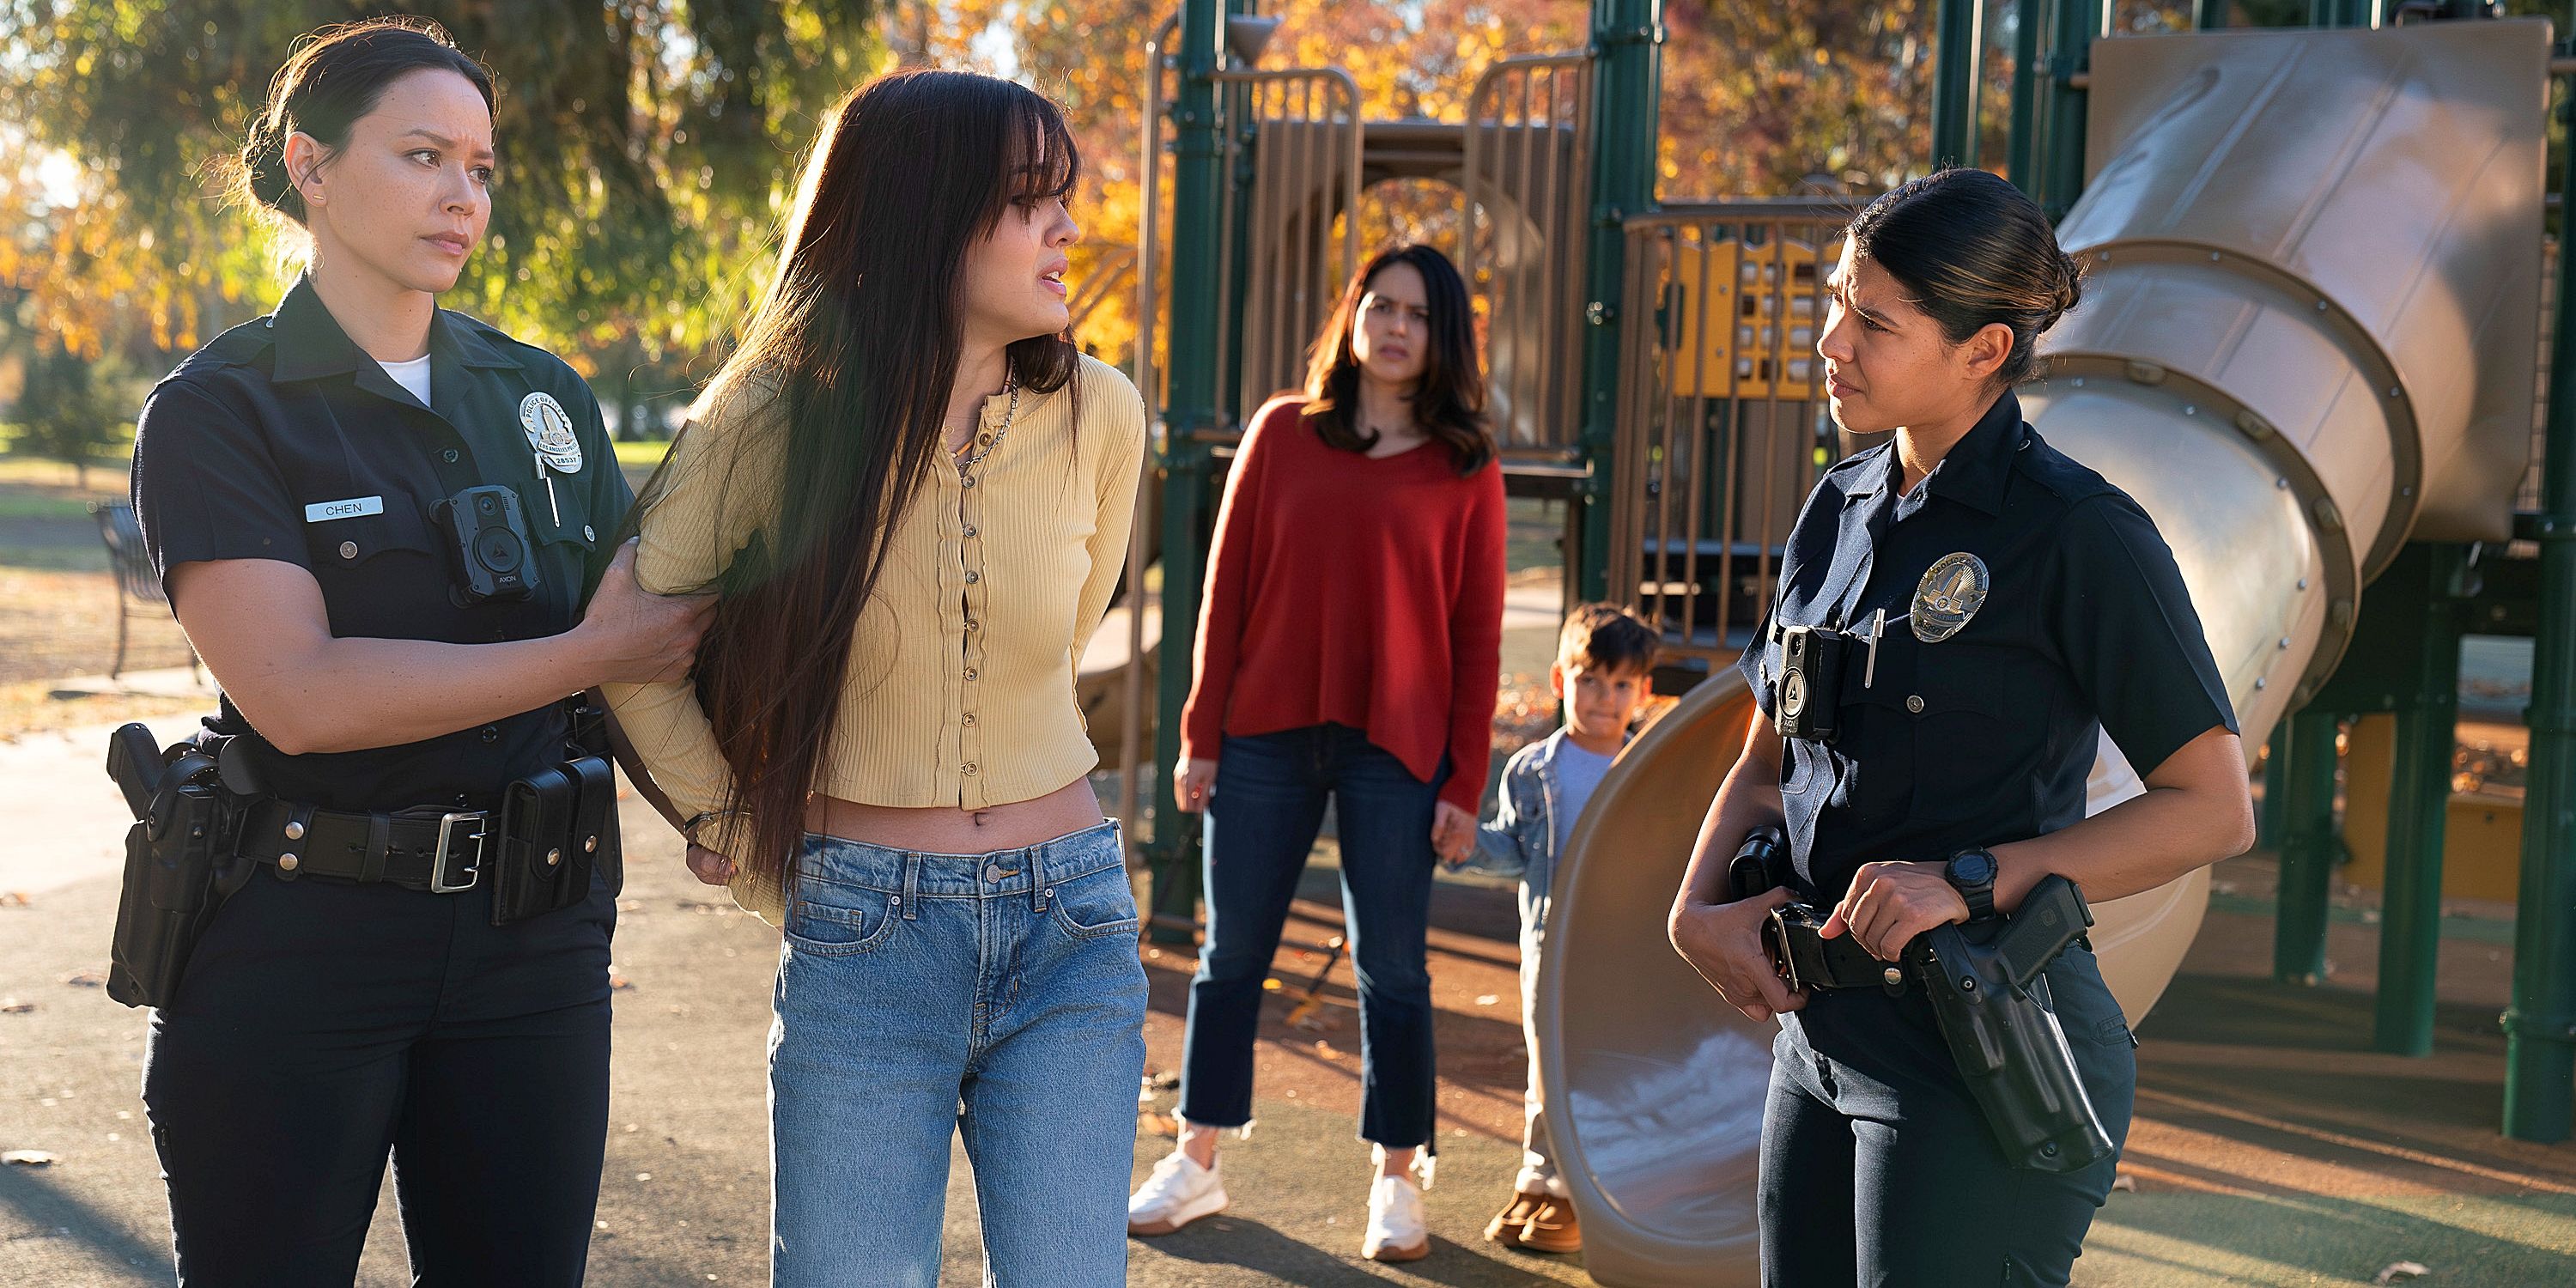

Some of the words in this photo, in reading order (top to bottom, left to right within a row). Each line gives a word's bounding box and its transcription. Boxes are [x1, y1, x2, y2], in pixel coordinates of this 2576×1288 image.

[526, 398, 540, 418] POLICE
[540, 398, 565, 417] OFFICER
[539, 442, 549, 451] LOS
[326, 503, 362, 515] CHEN
[1936, 557, 1965, 573] POLICE
